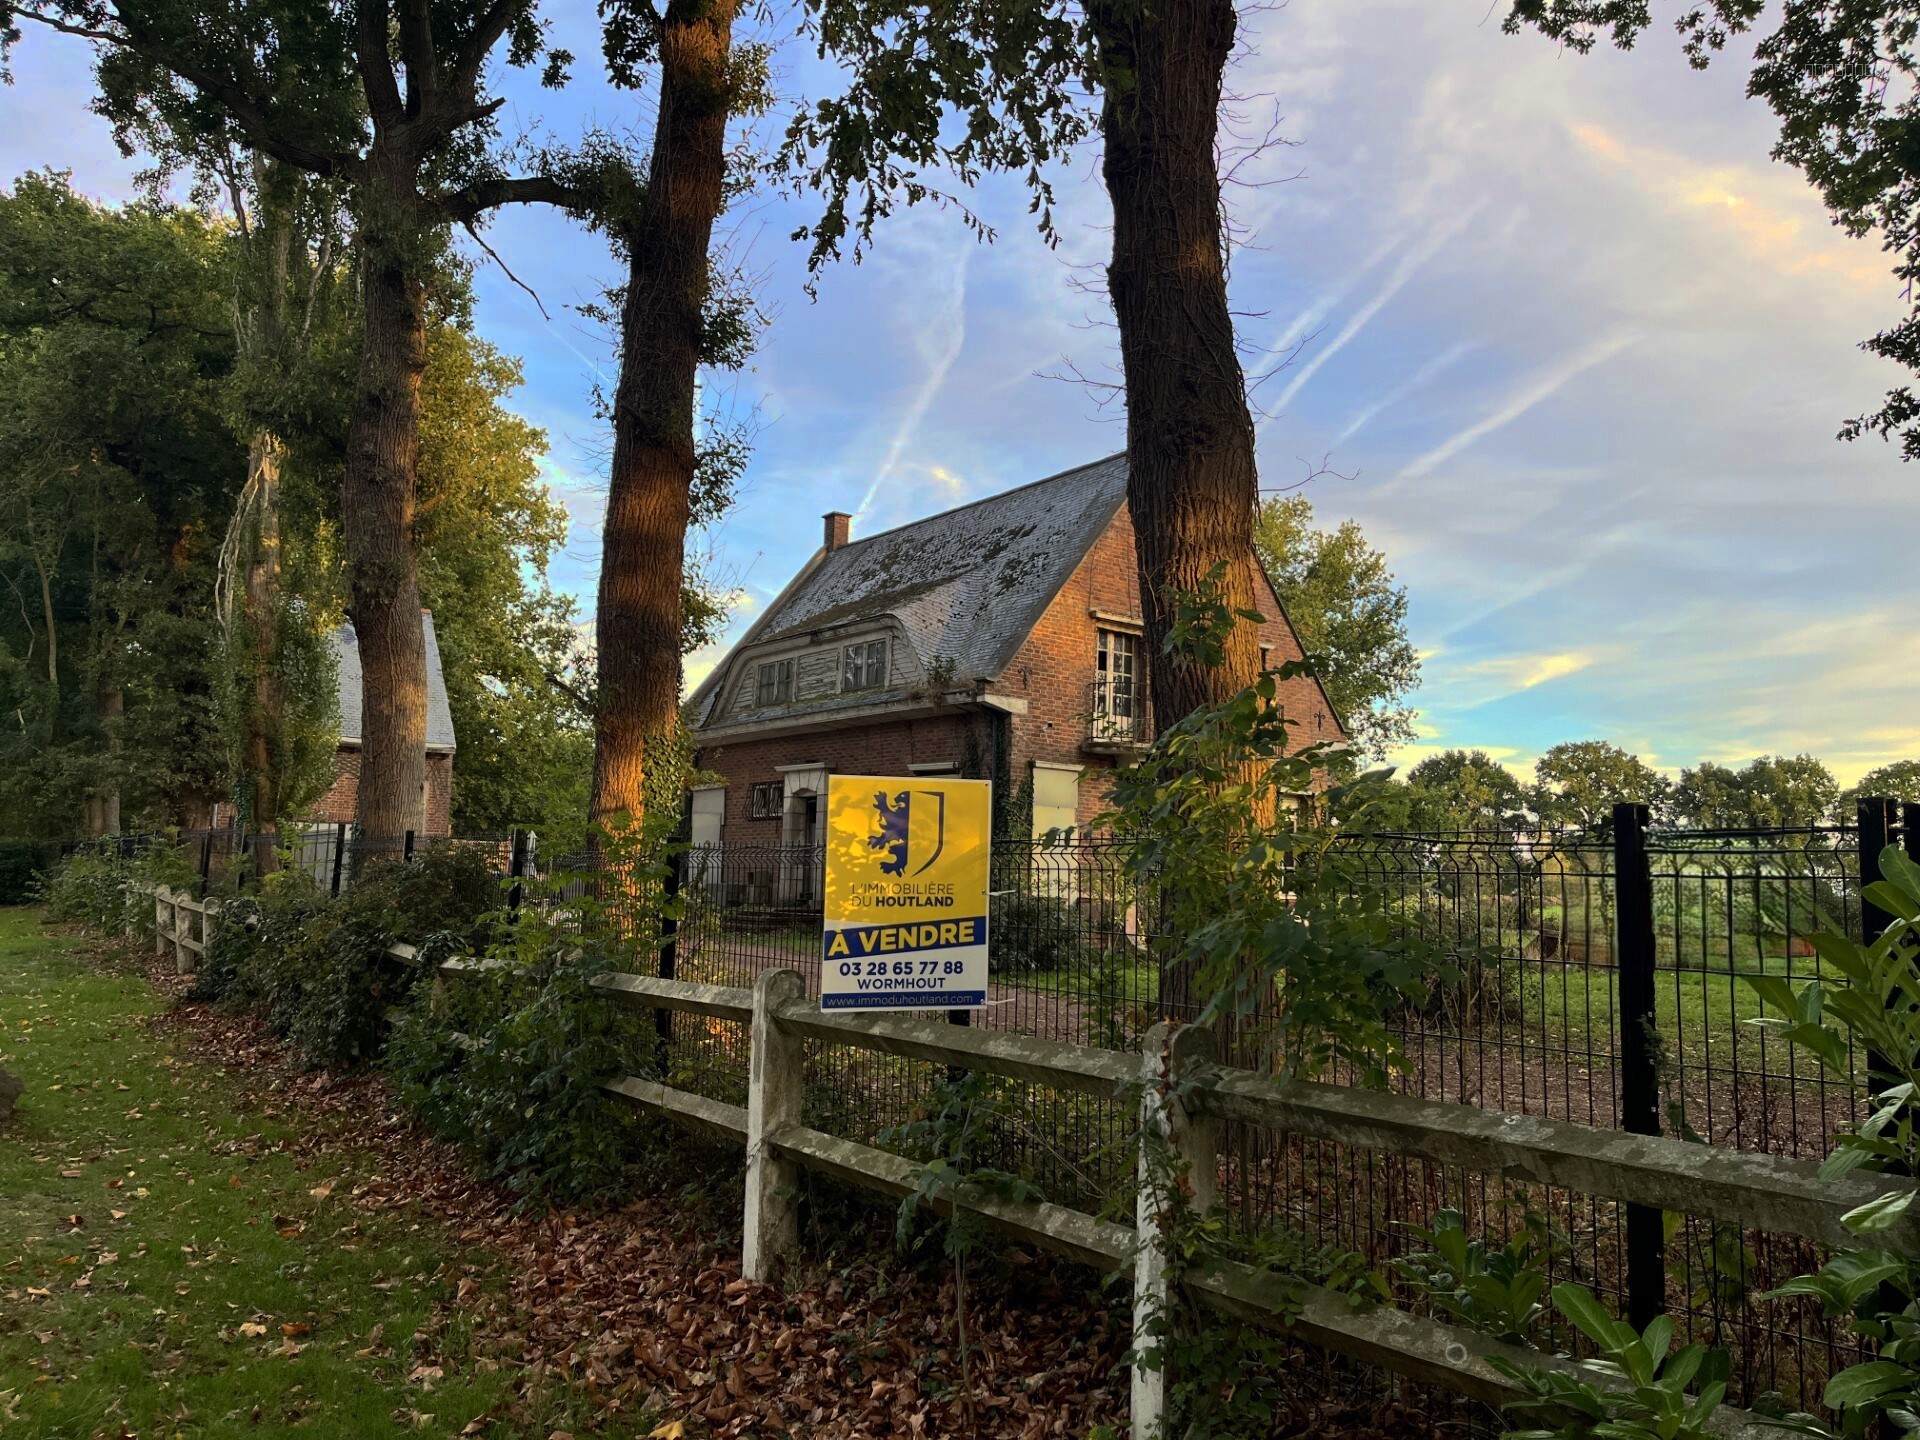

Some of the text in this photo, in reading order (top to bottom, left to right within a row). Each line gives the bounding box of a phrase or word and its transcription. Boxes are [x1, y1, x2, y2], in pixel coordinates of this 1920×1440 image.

[852, 881, 954, 895] L'IMMOBILIÈRE
[851, 896, 954, 907] DU HOUTLAND
[828, 921, 975, 957] À VENDRE
[839, 961, 964, 976] 03 28 65 77 88
[857, 977, 946, 990] WORMHOUT
[827, 994, 973, 1006] www.immoduhoutland.com
